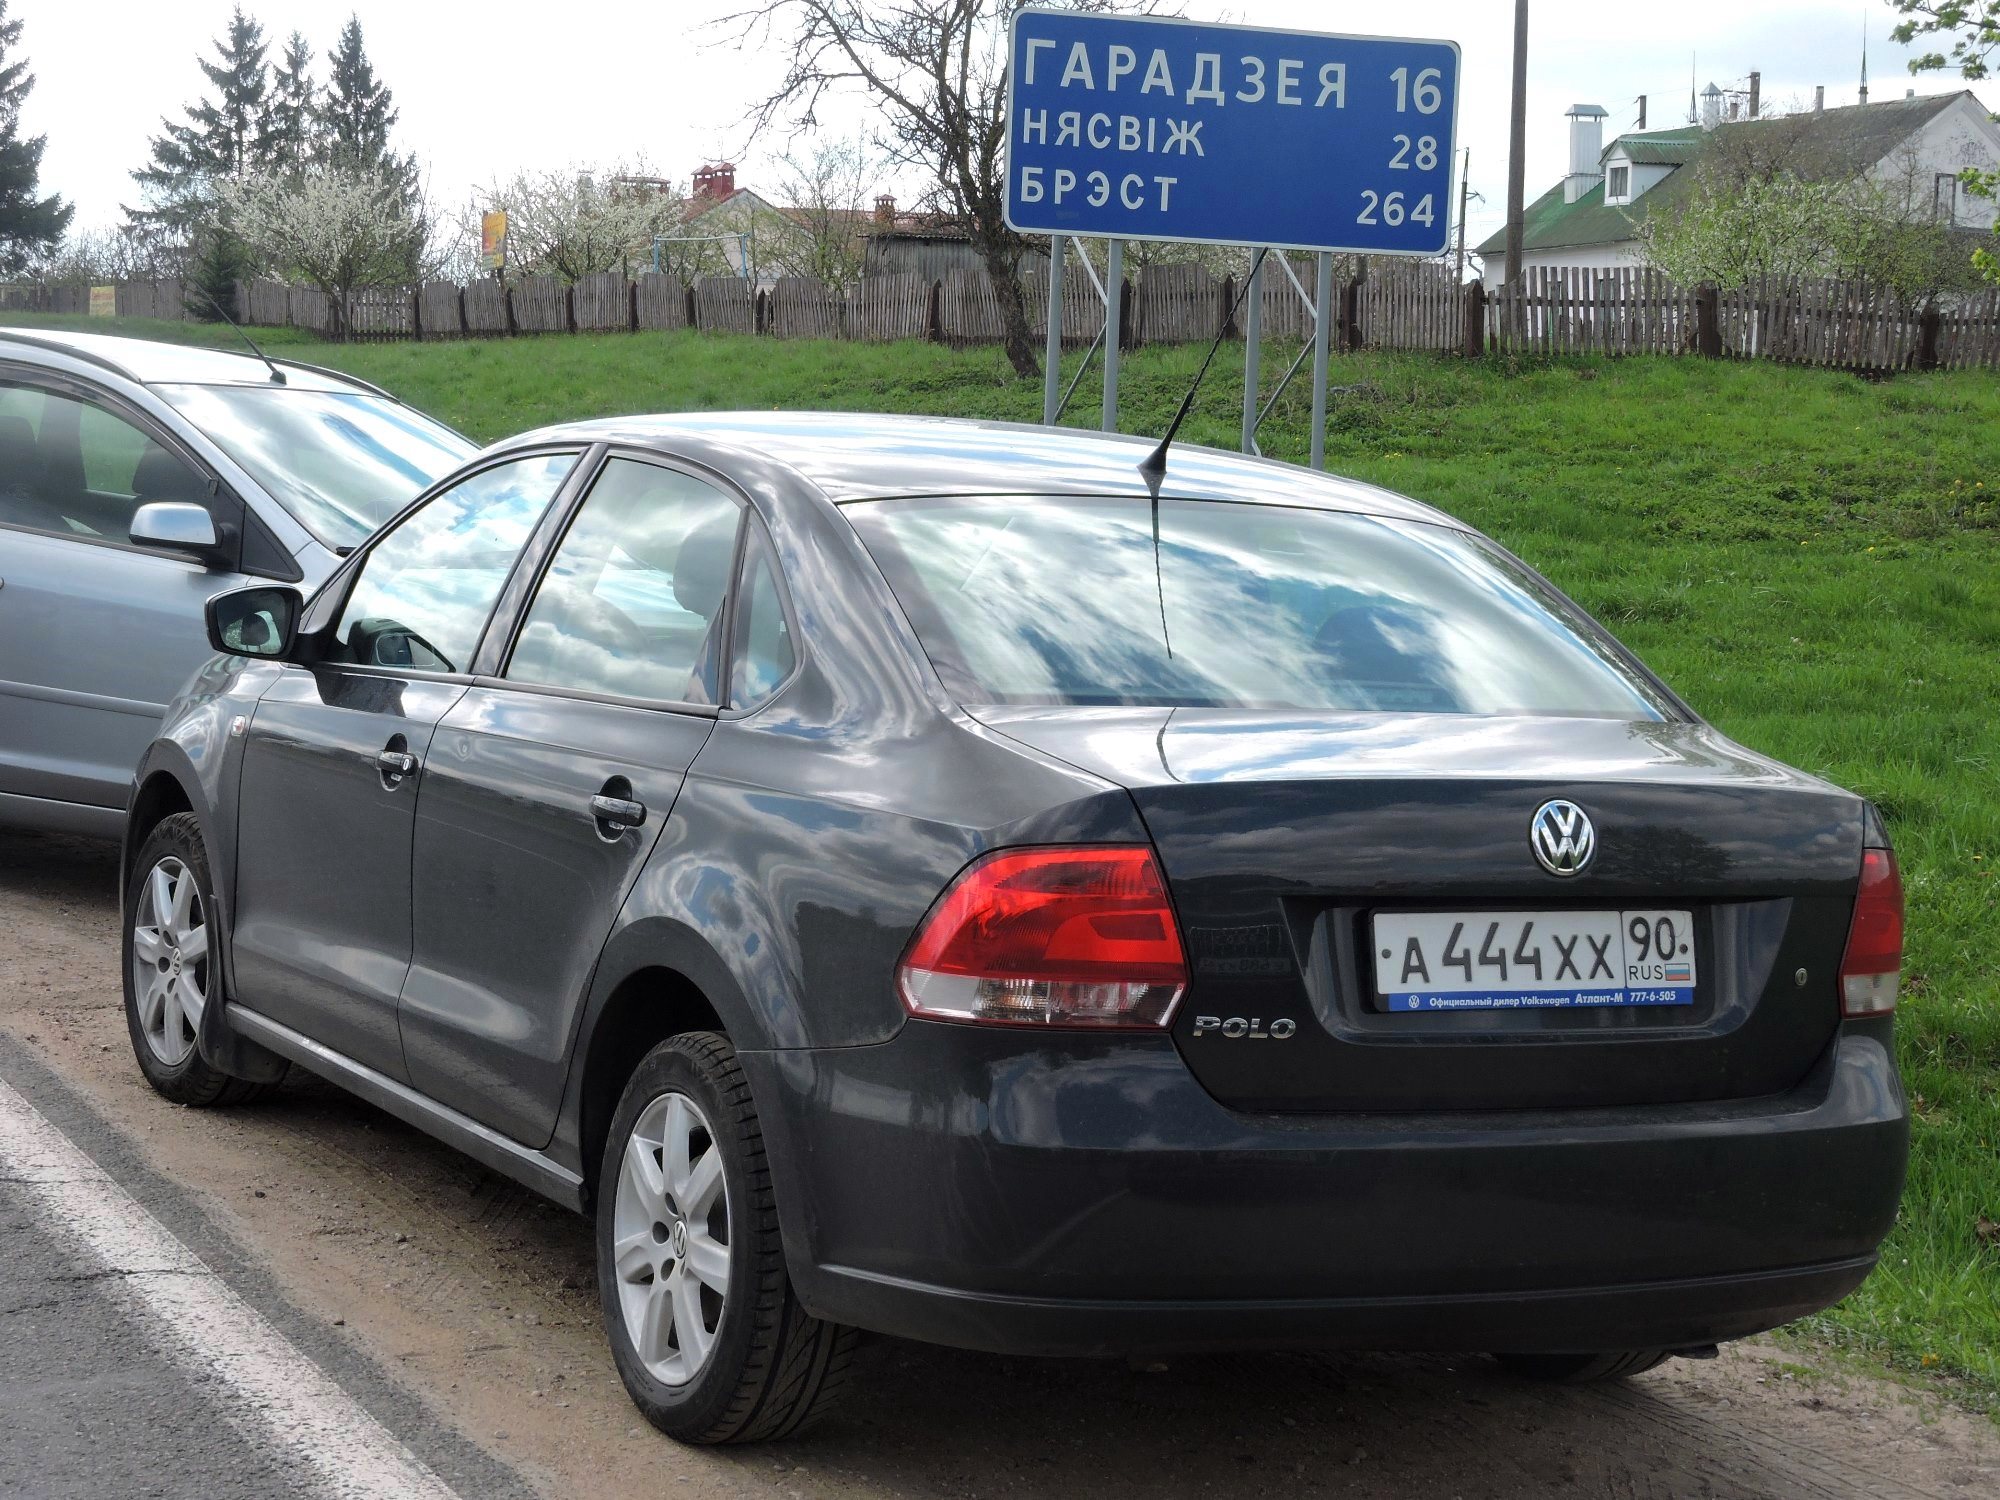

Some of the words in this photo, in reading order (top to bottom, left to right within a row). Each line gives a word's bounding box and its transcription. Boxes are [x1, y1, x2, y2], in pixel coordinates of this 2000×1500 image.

[1025, 38, 1346, 109] ГАРАДЗЕЯ
[1389, 67, 1442, 115] 16
[1023, 108, 1205, 157] НЯСВІЖ
[1388, 134, 1438, 171] 28
[1021, 167, 1178, 212] БРЭСТ
[1356, 189, 1435, 228] 264
[1629, 916, 1676, 961] 90
[1628, 965, 1663, 980] RUS
[1429, 997, 1492, 1008] Официальный
[1493, 997, 1520, 1007] дилер
[1521, 995, 1570, 1006] Volkswagen
[1575, 993, 1623, 1004] Атлант-М
[1630, 991, 1676, 1001] 777-6-505
[1193, 1015, 1296, 1039] POLO
